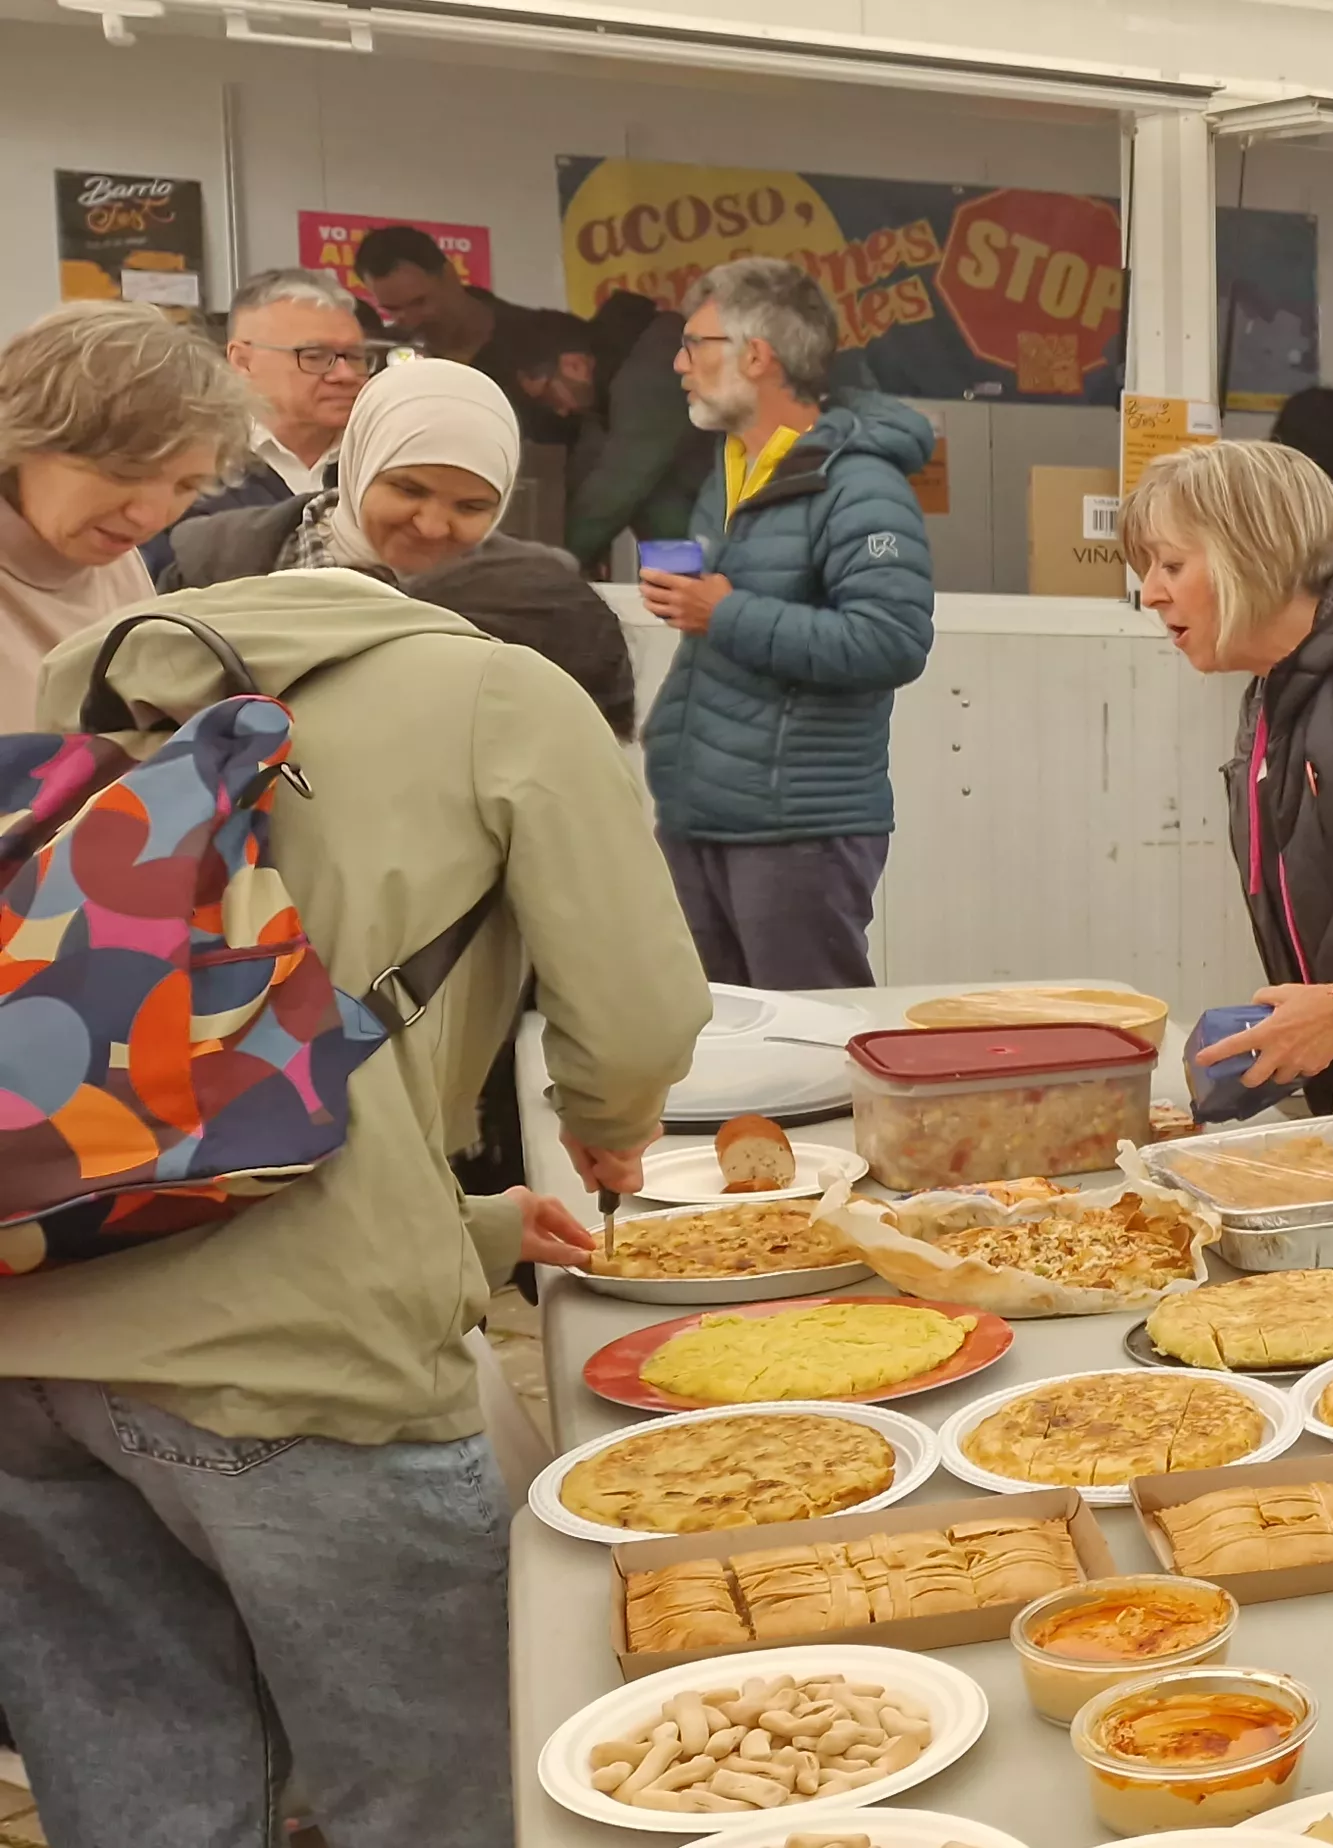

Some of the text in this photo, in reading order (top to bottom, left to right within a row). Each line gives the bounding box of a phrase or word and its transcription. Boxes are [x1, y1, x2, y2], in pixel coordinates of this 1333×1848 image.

[78, 176, 173, 207] Barrio
[576, 186, 814, 265] acoso,
[957, 219, 1122, 331] STOP
